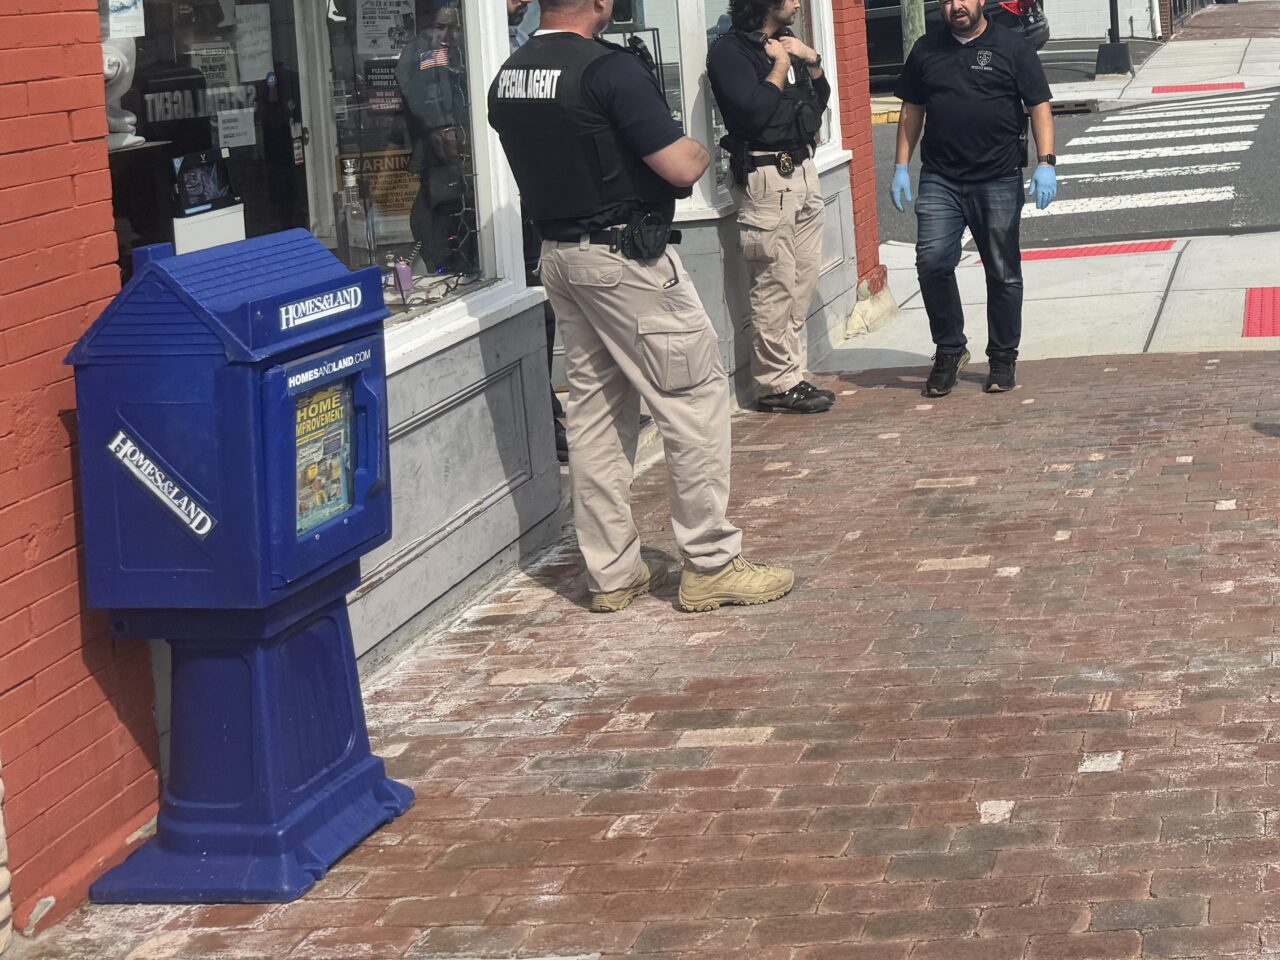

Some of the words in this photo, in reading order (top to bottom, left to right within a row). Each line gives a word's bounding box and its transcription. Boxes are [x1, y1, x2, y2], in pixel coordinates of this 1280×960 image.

[497, 68, 527, 99] SPECIAL
[527, 68, 562, 99] AGENT
[354, 156, 410, 172] ARNIN
[280, 286, 362, 330] HOMES&LAND
[288, 348, 371, 388] HOMESANDLAND.COM
[296, 394, 341, 423] HOME
[107, 430, 212, 535] HOMES&LAND
